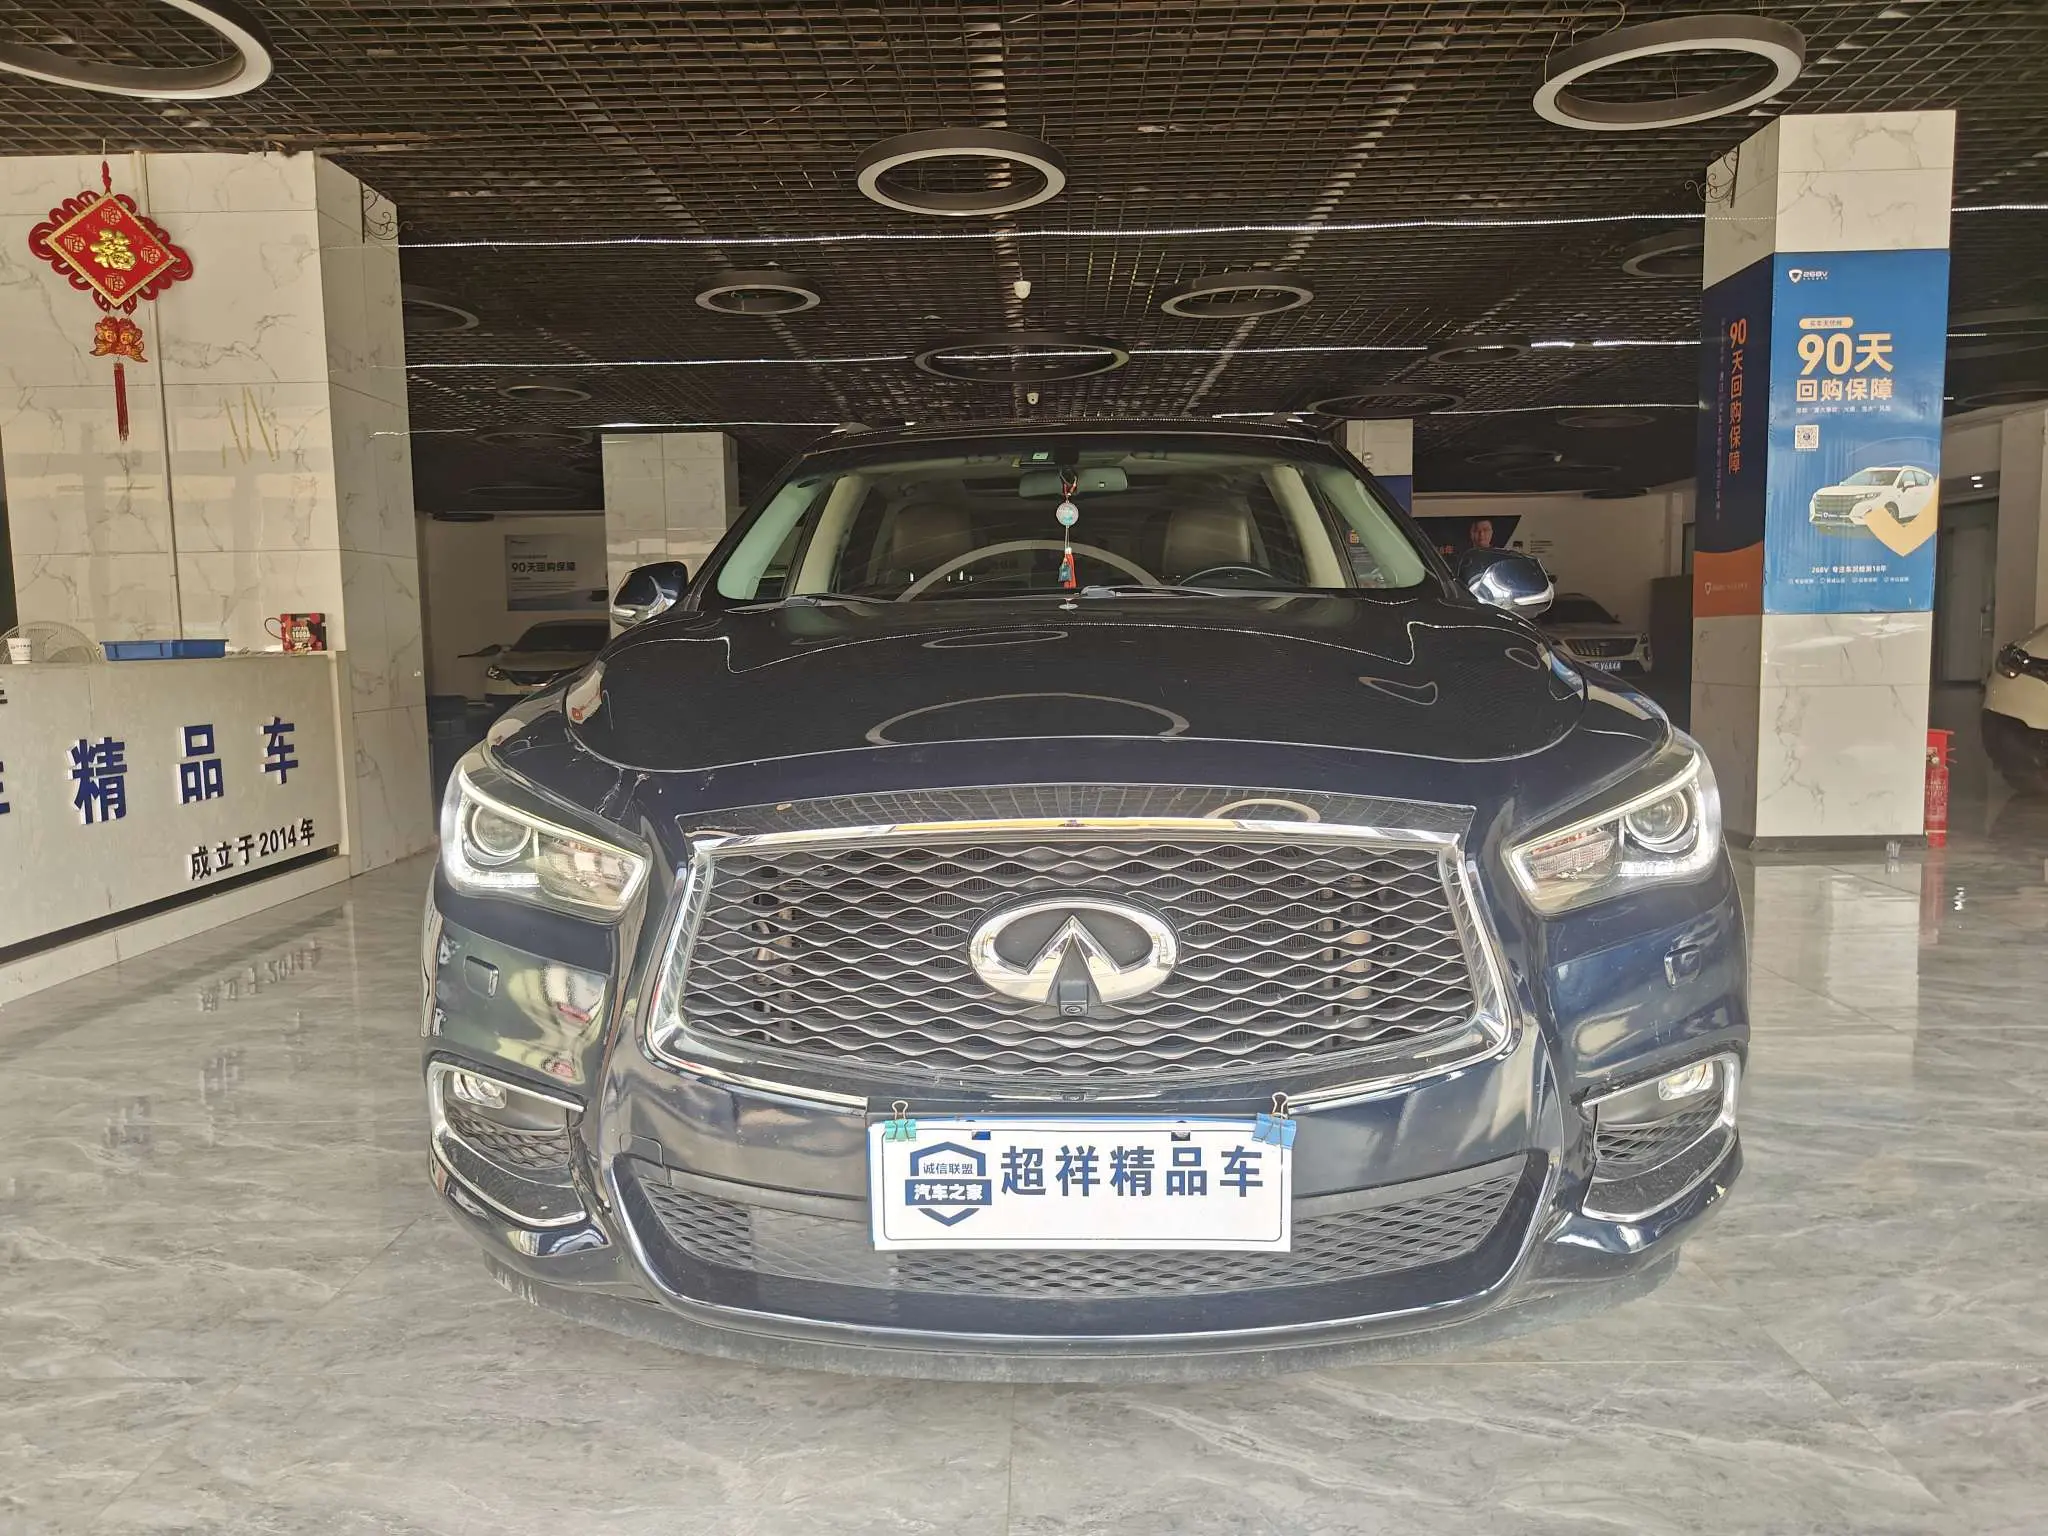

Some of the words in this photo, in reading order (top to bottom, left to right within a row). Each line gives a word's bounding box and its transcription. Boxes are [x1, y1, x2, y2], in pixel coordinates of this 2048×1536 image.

[1797, 332, 1894, 375] 90天
[1728, 318, 1747, 474] 90天回购保障
[1796, 377, 1893, 401] 回购保障
[0, 716, 299, 826] 精品车
[189, 818, 315, 880] 成立于2014年
[913, 1183, 983, 1201] 汽车之家
[923, 1162, 973, 1175] 诚信联盟
[1000, 1145, 1264, 1198] 超祥精品车
